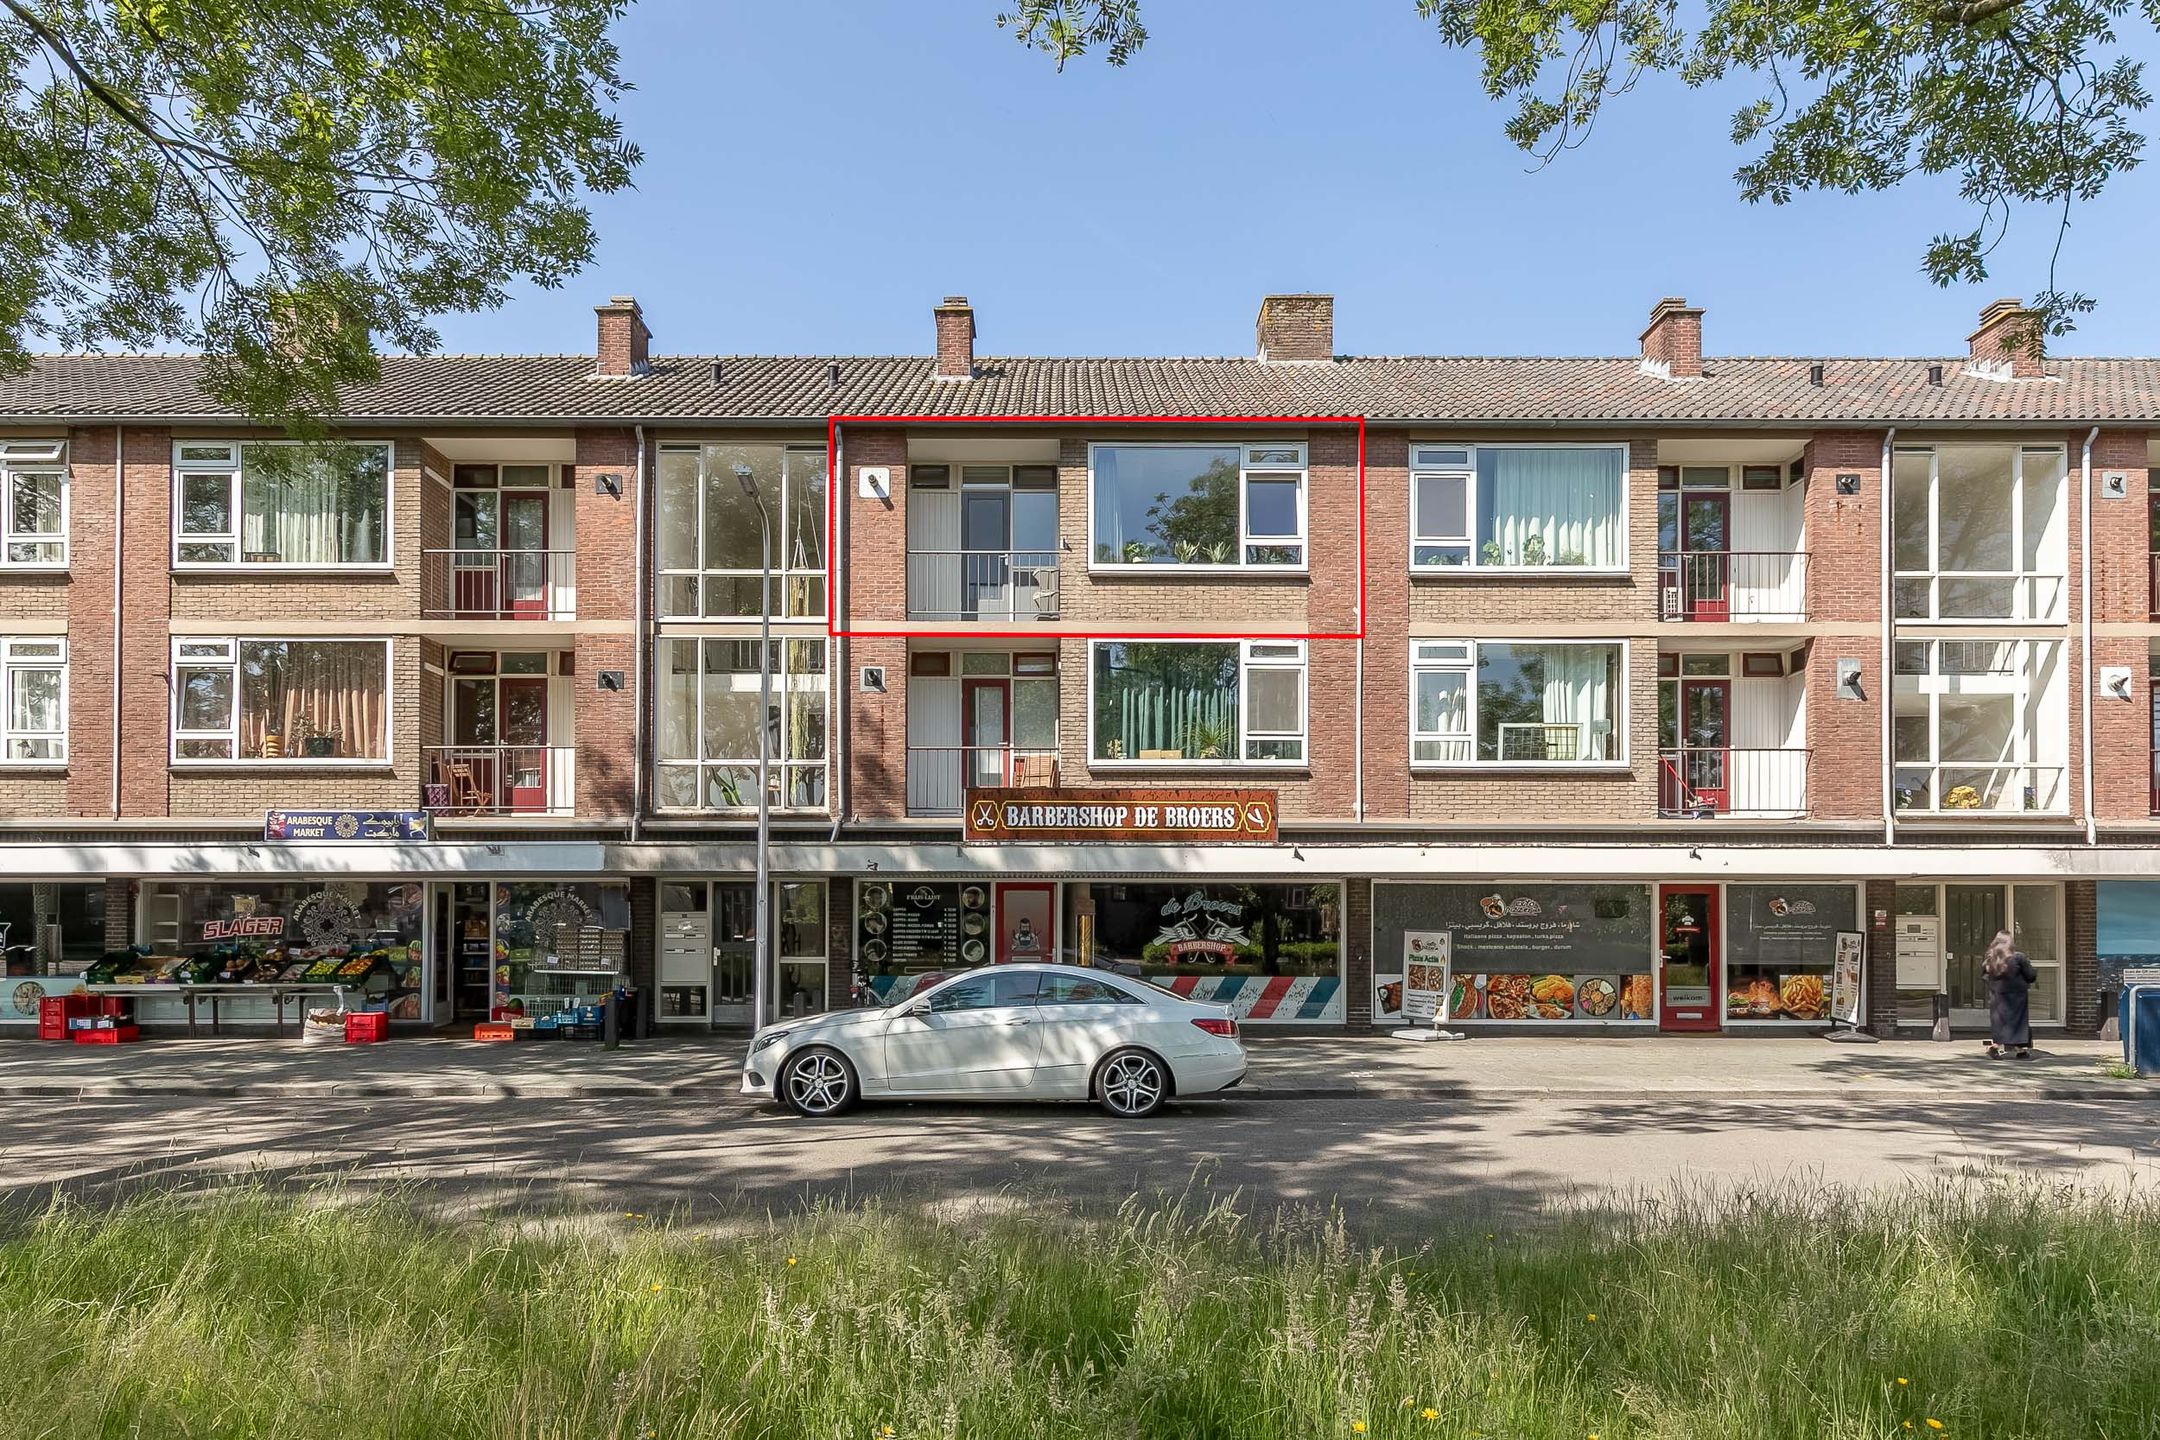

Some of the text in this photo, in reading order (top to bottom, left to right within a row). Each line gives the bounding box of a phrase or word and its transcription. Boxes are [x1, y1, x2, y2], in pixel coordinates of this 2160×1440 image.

[286, 815, 333, 825] ARABESQUE
[1006, 805, 1236, 828] BARBERSHOP DE BROERS
[293, 828, 326, 837] MARKET
[292, 890, 362, 922] ARABESQUE MARKET
[525, 891, 593, 922] ARABESQUE MARKET
[1160, 890, 1243, 916] de Broers
[203, 917, 284, 940] SLAGER
[1177, 940, 1227, 952] BARBERSHOP
